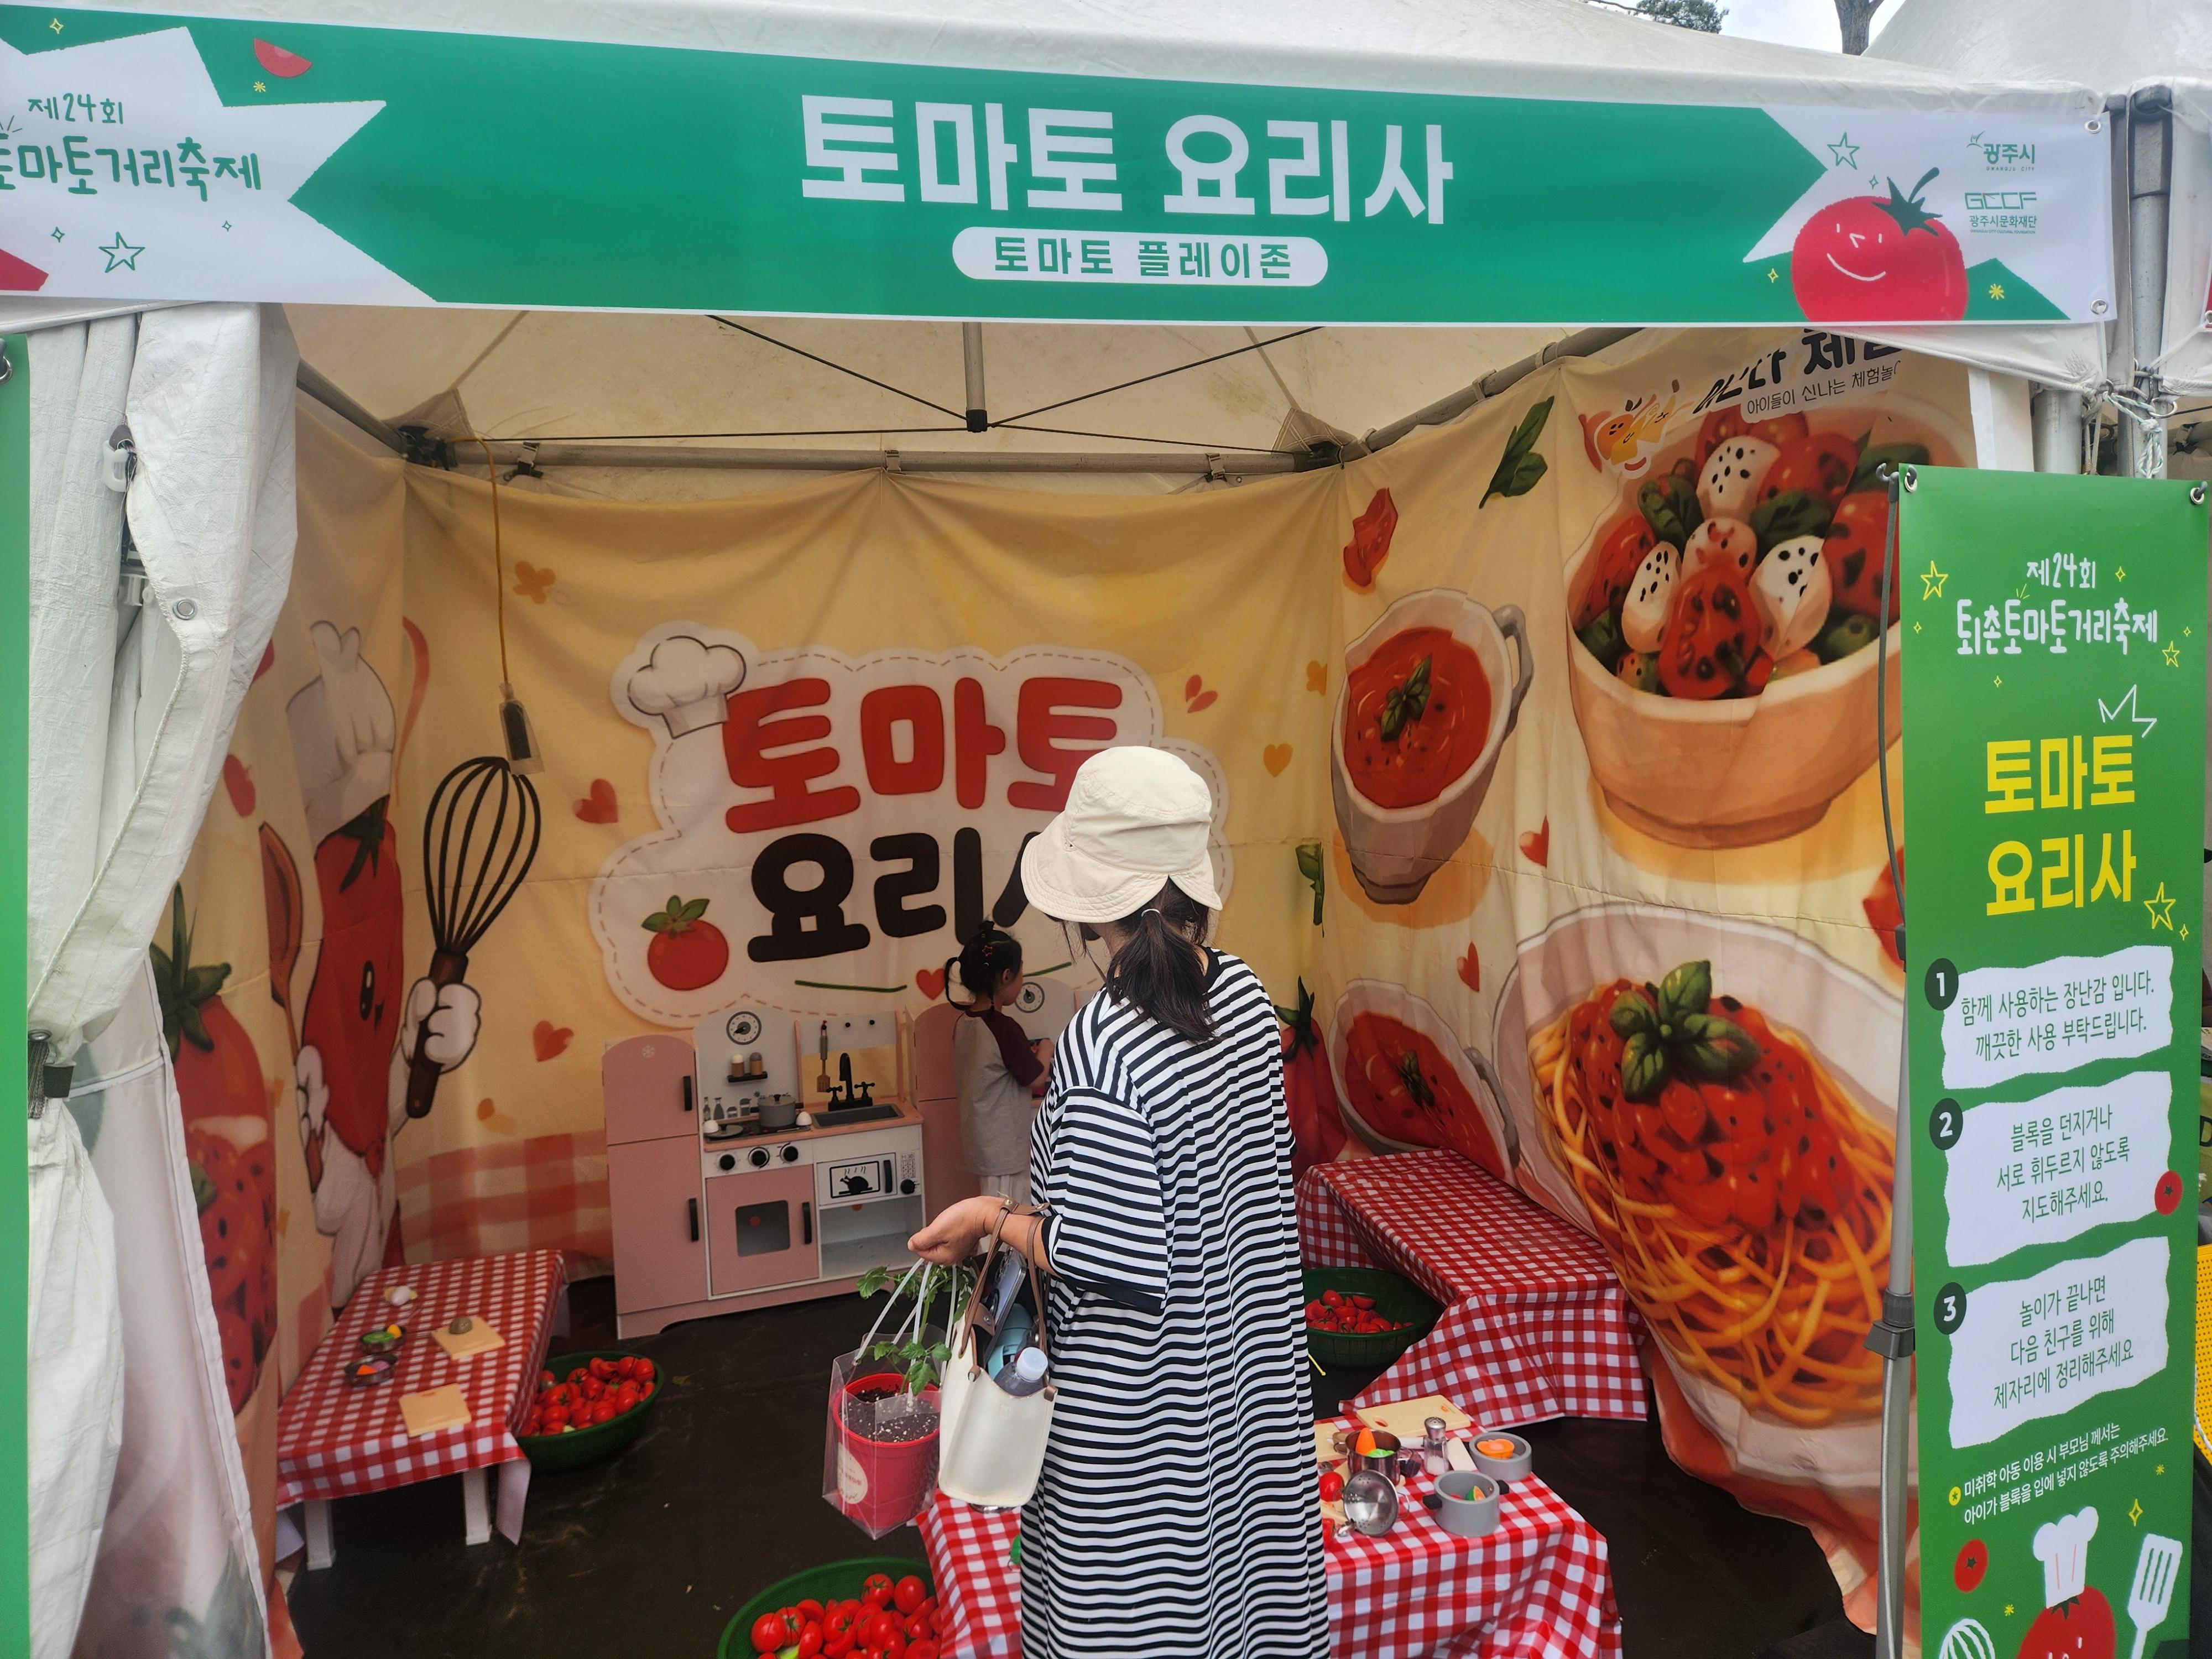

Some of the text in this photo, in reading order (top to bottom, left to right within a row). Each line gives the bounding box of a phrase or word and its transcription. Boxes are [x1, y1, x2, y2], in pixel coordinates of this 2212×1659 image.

[28, 93, 123, 124] 제24회
[802, 95, 1453, 223] 토마토 요리사
[1984, 144, 2035, 164] 광주시
[1965, 192, 2037, 209] GCCF
[1969, 215, 2037, 228] 광주시문화재단
[995, 236, 1291, 279] 토마토 플레이존
[1747, 389, 1794, 414] 아이들이
[1802, 379, 1845, 401] 신나는
[2027, 552, 2096, 588] 제24회
[1957, 597, 2157, 655] 퇴촌토마토거리축제
[722, 676, 1123, 833] 토마토
[1985, 735, 2135, 813] 토마토
[1986, 830, 2136, 916] 요리사
[1936, 972, 1945, 997] 1
[1961, 969, 2154, 1026] 함께 사용하는 장난감 입니다.
[1976, 1007, 2146, 1061] 깨끗한 사용 부탁드립니다.
[1939, 1112, 1953, 1138] 2
[2011, 1104, 2112, 1152] 블록을 던지거나
[1997, 1136, 2130, 1192] 서로 휘두르지 않도록
[2022, 1181, 2108, 1223] 지도해주세요.
[1943, 1296, 1957, 1322] 3
[2020, 1275, 2105, 1328] 놀이가 끝나면
[2011, 1308, 2114, 1365] 다음 친구를 위해
[1994, 1339, 2133, 1408] 제자리에 정리해주세요
[1964, 1423, 2120, 1498] 미취학 아동 이용 시 부모님 께서는
[1964, 1428, 2168, 1525] 아이가 블록을 입에 넣지 않도록 주의해주세요.
